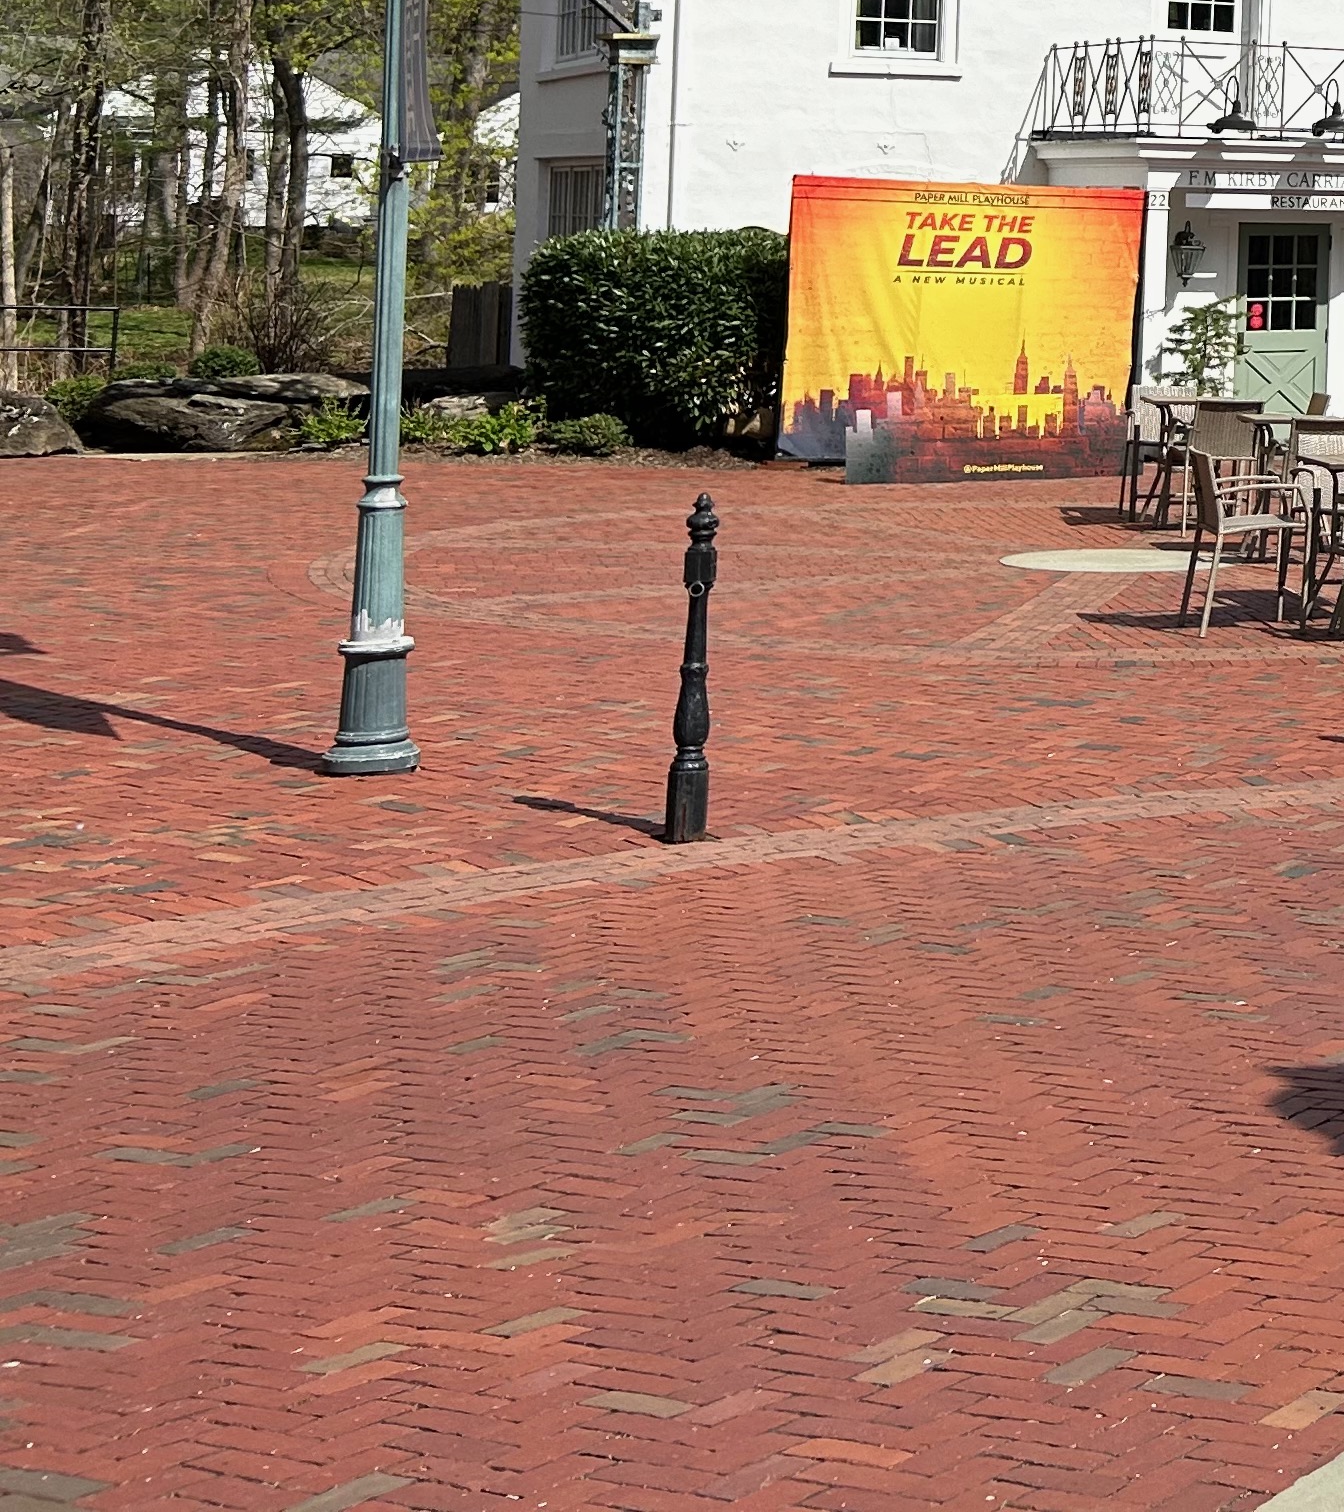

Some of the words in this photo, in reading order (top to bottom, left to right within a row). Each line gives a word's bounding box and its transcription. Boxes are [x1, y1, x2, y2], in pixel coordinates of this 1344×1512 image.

[1228, 172, 1280, 187] KIRBY
[914, 192, 945, 204] PAPER
[948, 192, 969, 204] MILL
[972, 193, 1031, 206] PLAYHOUSE
[1150, 194, 1167, 207] 22
[906, 211, 976, 232] TAKE
[983, 215, 1036, 233] THE
[897, 233, 1033, 269] LEAD
[893, 275, 902, 284] A
[912, 275, 946, 284] NEW
[956, 276, 1026, 286] MUSICAL
